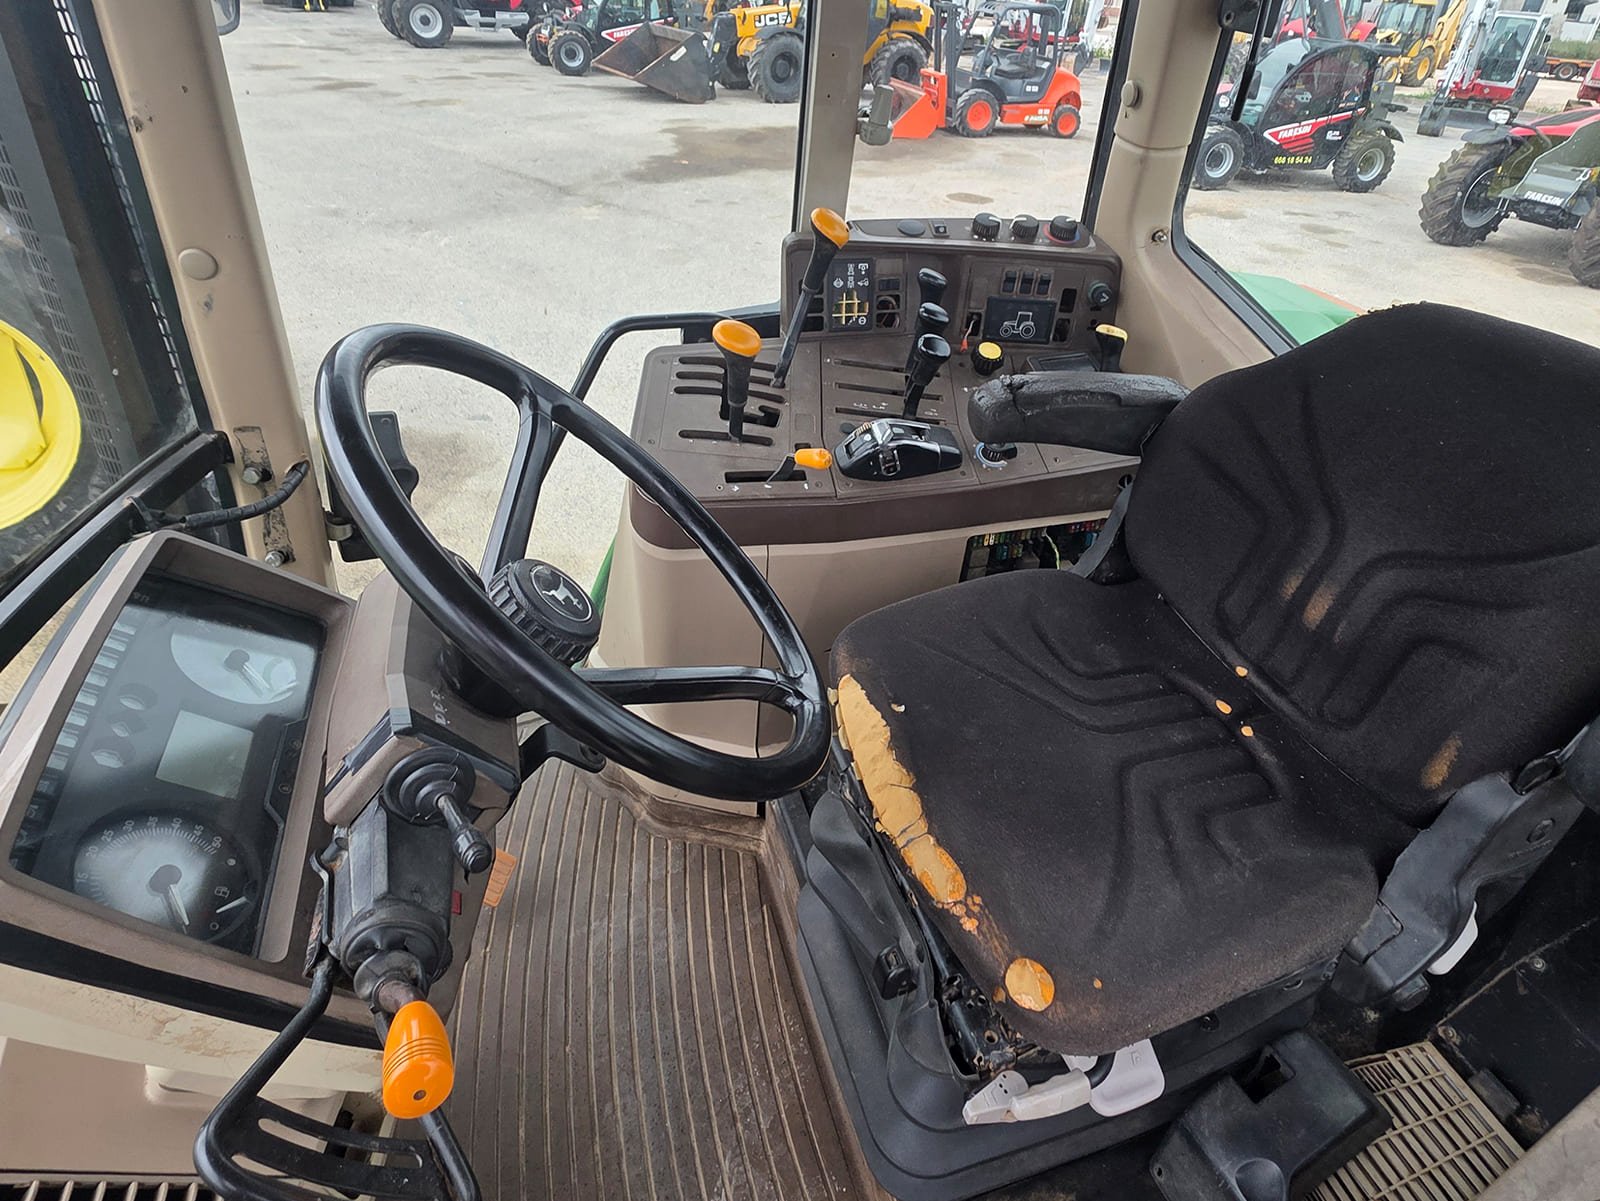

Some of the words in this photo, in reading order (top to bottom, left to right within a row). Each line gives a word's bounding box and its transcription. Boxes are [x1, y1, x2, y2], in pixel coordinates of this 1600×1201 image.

[755, 12, 791, 28] JCB
[1278, 124, 1313, 140] FARESIN
[1524, 190, 1565, 206] FARESIN
[122, 819, 135, 832] 30
[171, 817, 182, 830] 40
[101, 829, 114, 842] 25
[211, 836, 223, 849] 50
[86, 845, 99, 858] 20
[75, 872, 89, 883] 15
